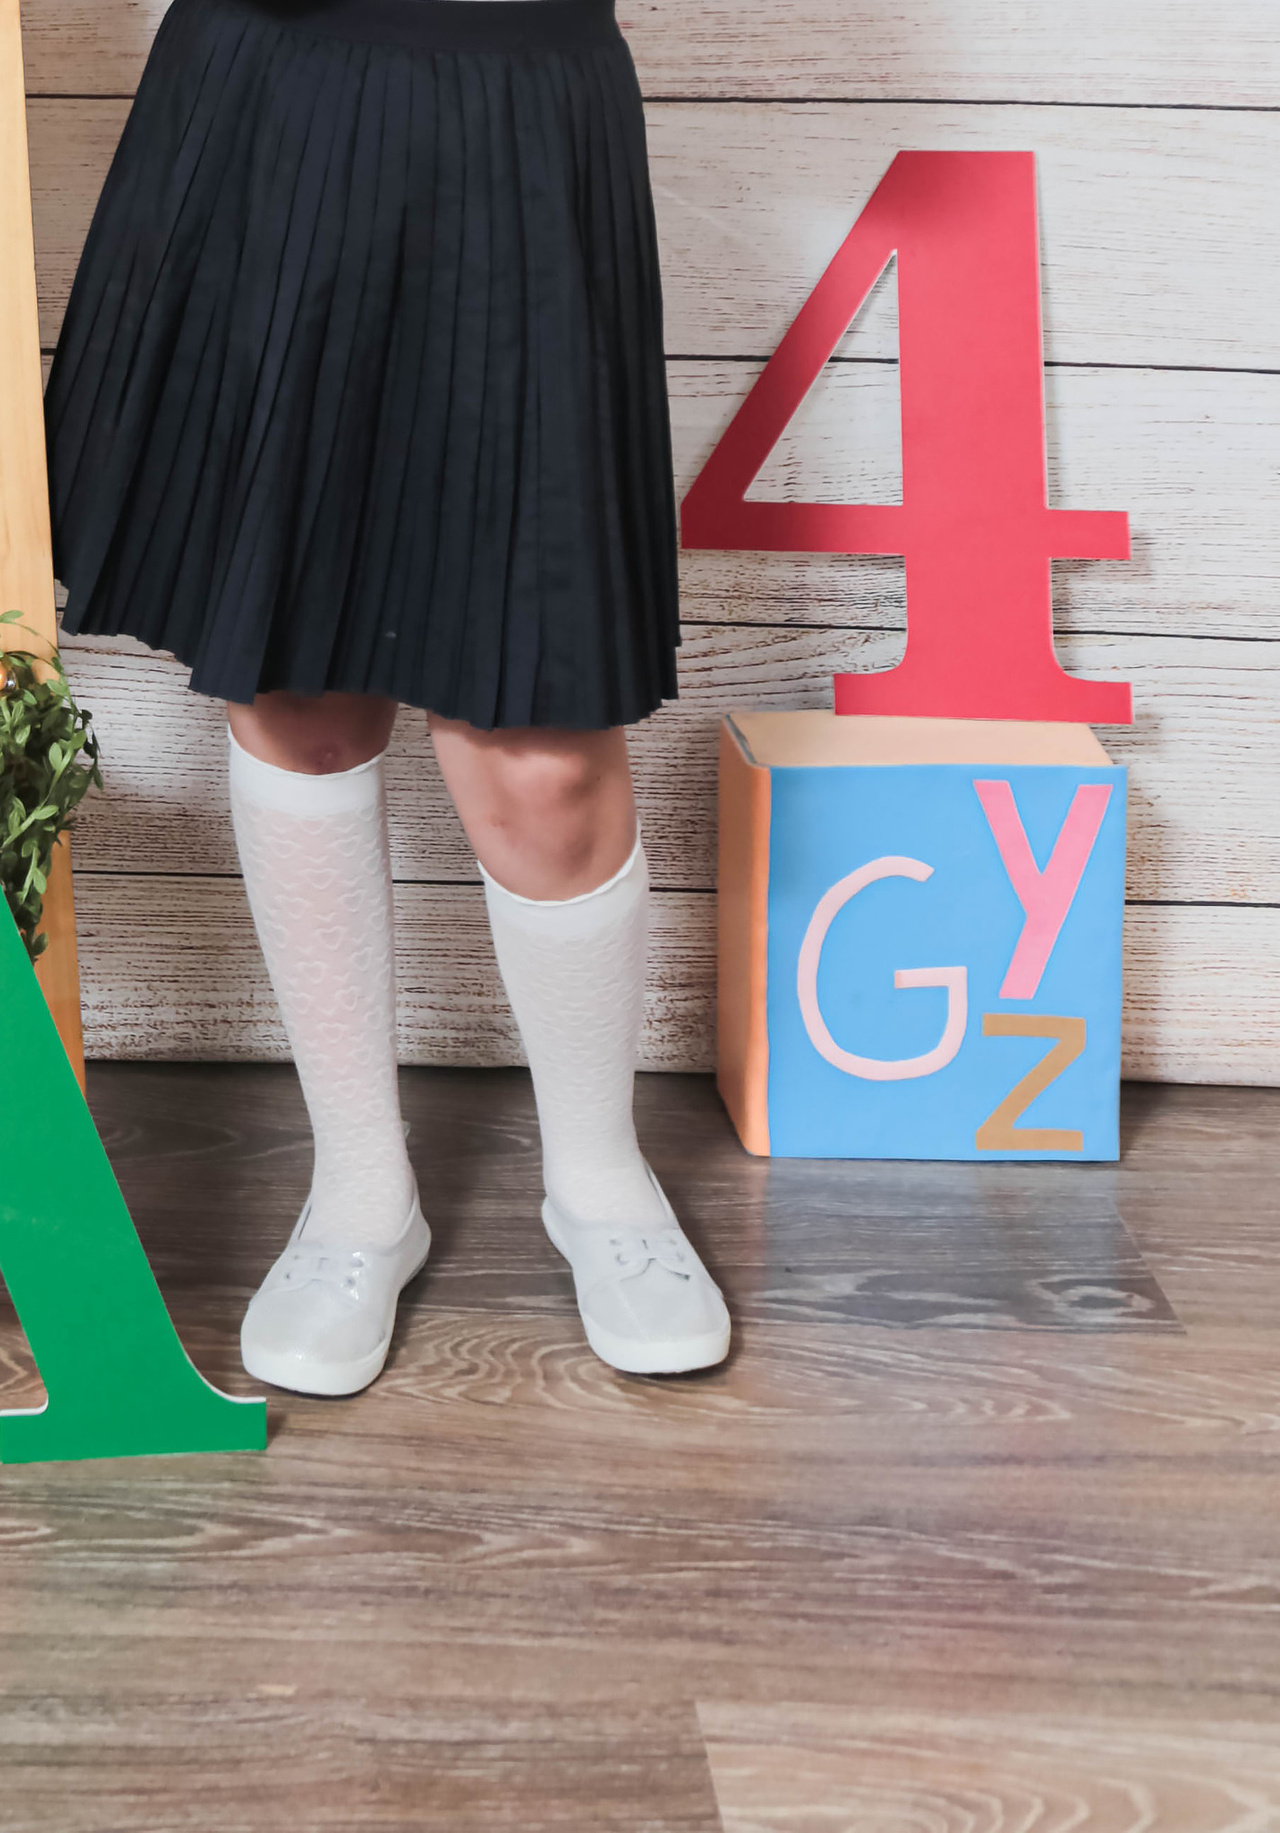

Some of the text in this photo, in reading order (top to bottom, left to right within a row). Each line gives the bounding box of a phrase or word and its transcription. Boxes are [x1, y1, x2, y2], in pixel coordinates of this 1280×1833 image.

[680, 150, 1133, 724] 4
[797, 855, 968, 1081] G
[973, 779, 1114, 1000] Y
[974, 1013, 1086, 1152] Z
